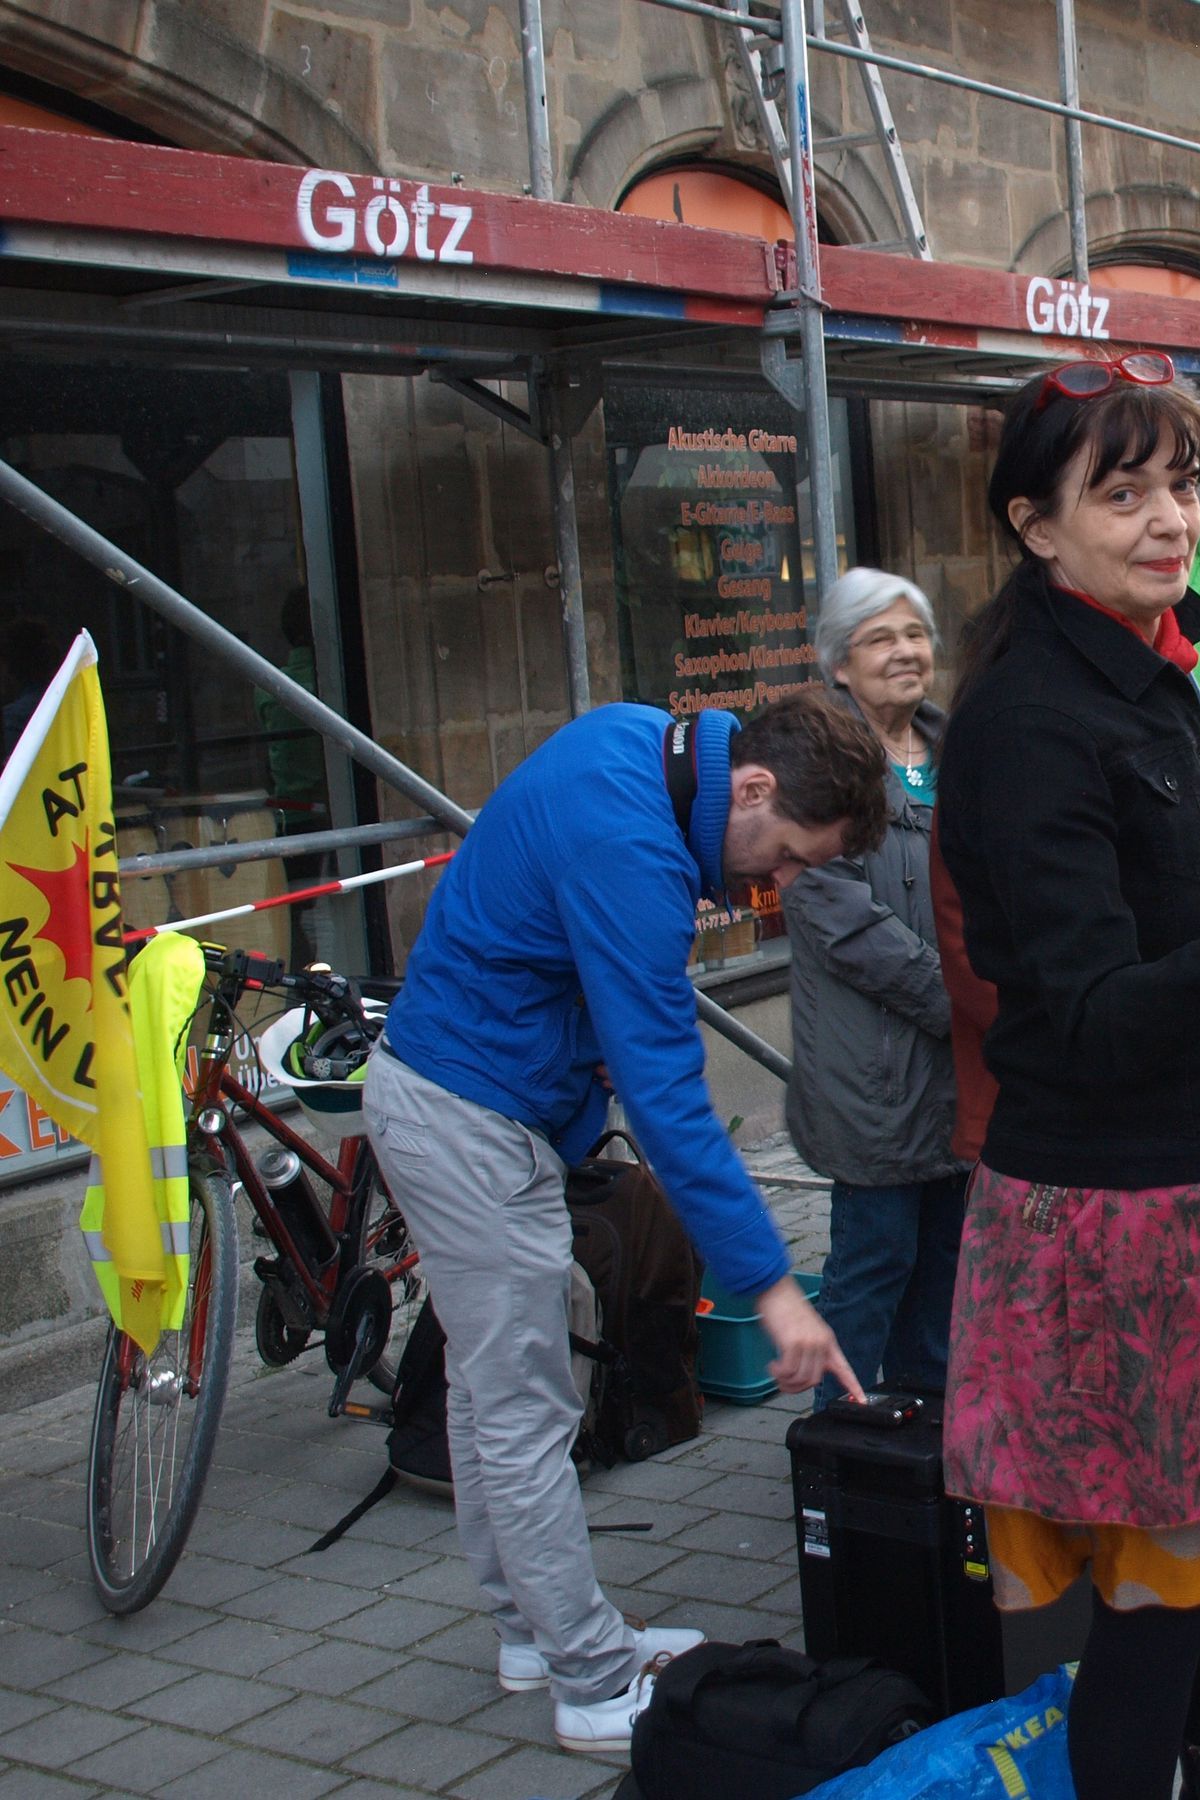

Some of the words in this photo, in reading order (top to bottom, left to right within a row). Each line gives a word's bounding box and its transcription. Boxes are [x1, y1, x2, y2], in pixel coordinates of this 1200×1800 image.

[297, 168, 474, 265] Götz
[1026, 276, 1110, 339] Götz
[668, 426, 747, 451] Akustische
[749, 429, 797, 452] Gitarre
[717, 575, 771, 600] Gesang
[684, 606, 808, 638] Klavier/Keyboard
[0, 917, 70, 1062] NEIN
